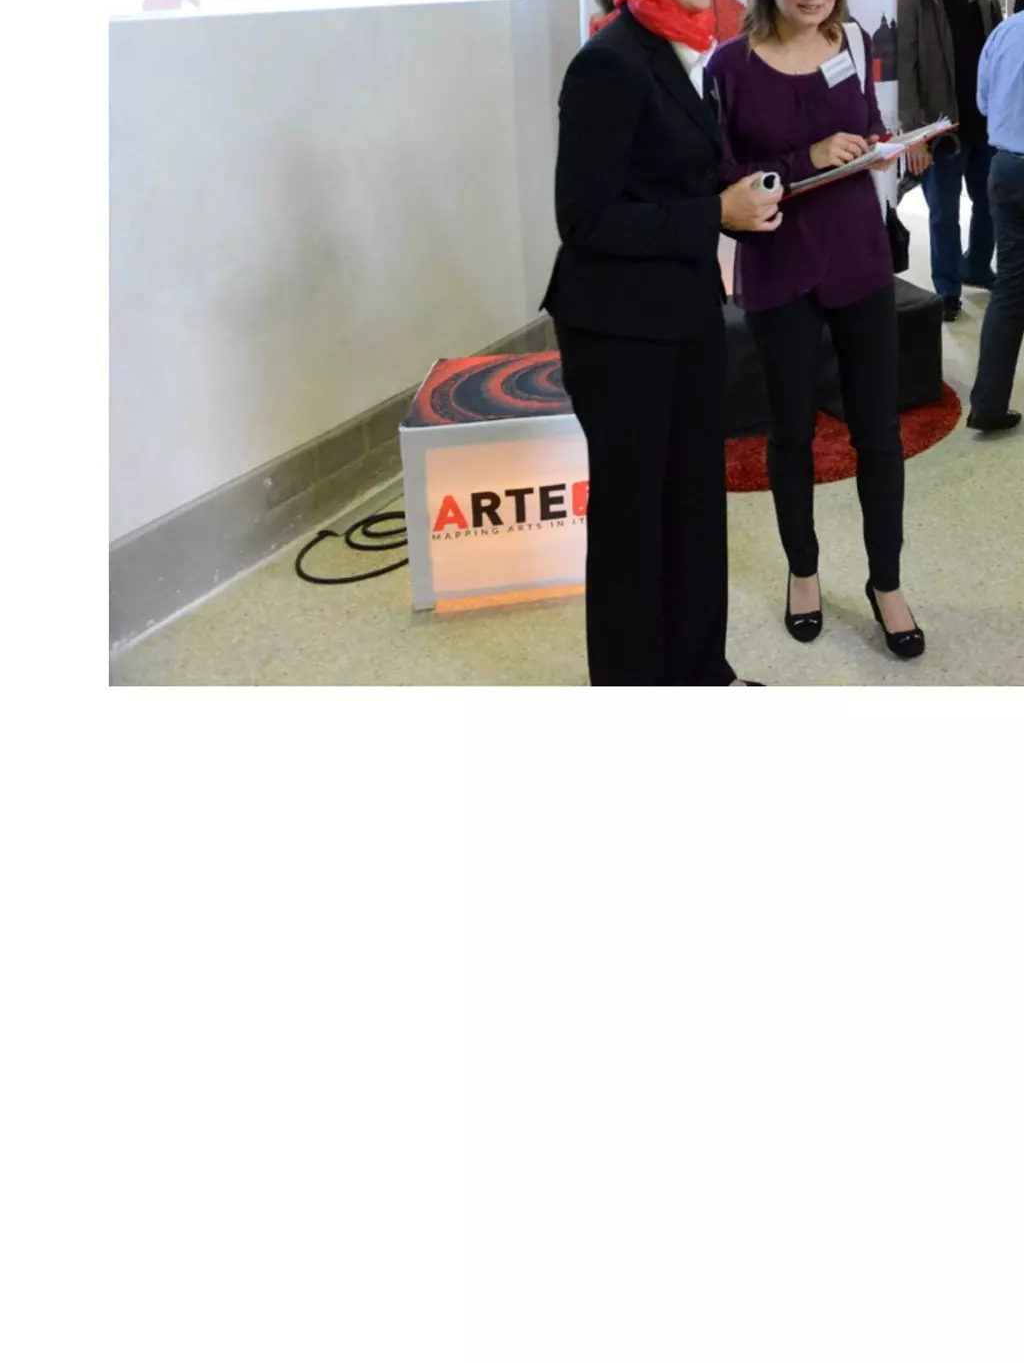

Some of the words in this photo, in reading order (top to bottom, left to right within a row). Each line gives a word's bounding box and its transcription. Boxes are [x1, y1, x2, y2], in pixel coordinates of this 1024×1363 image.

[432, 528, 500, 541] MAPPING
[507, 522, 543, 534] ARTS
[550, 520, 565, 529] IN
